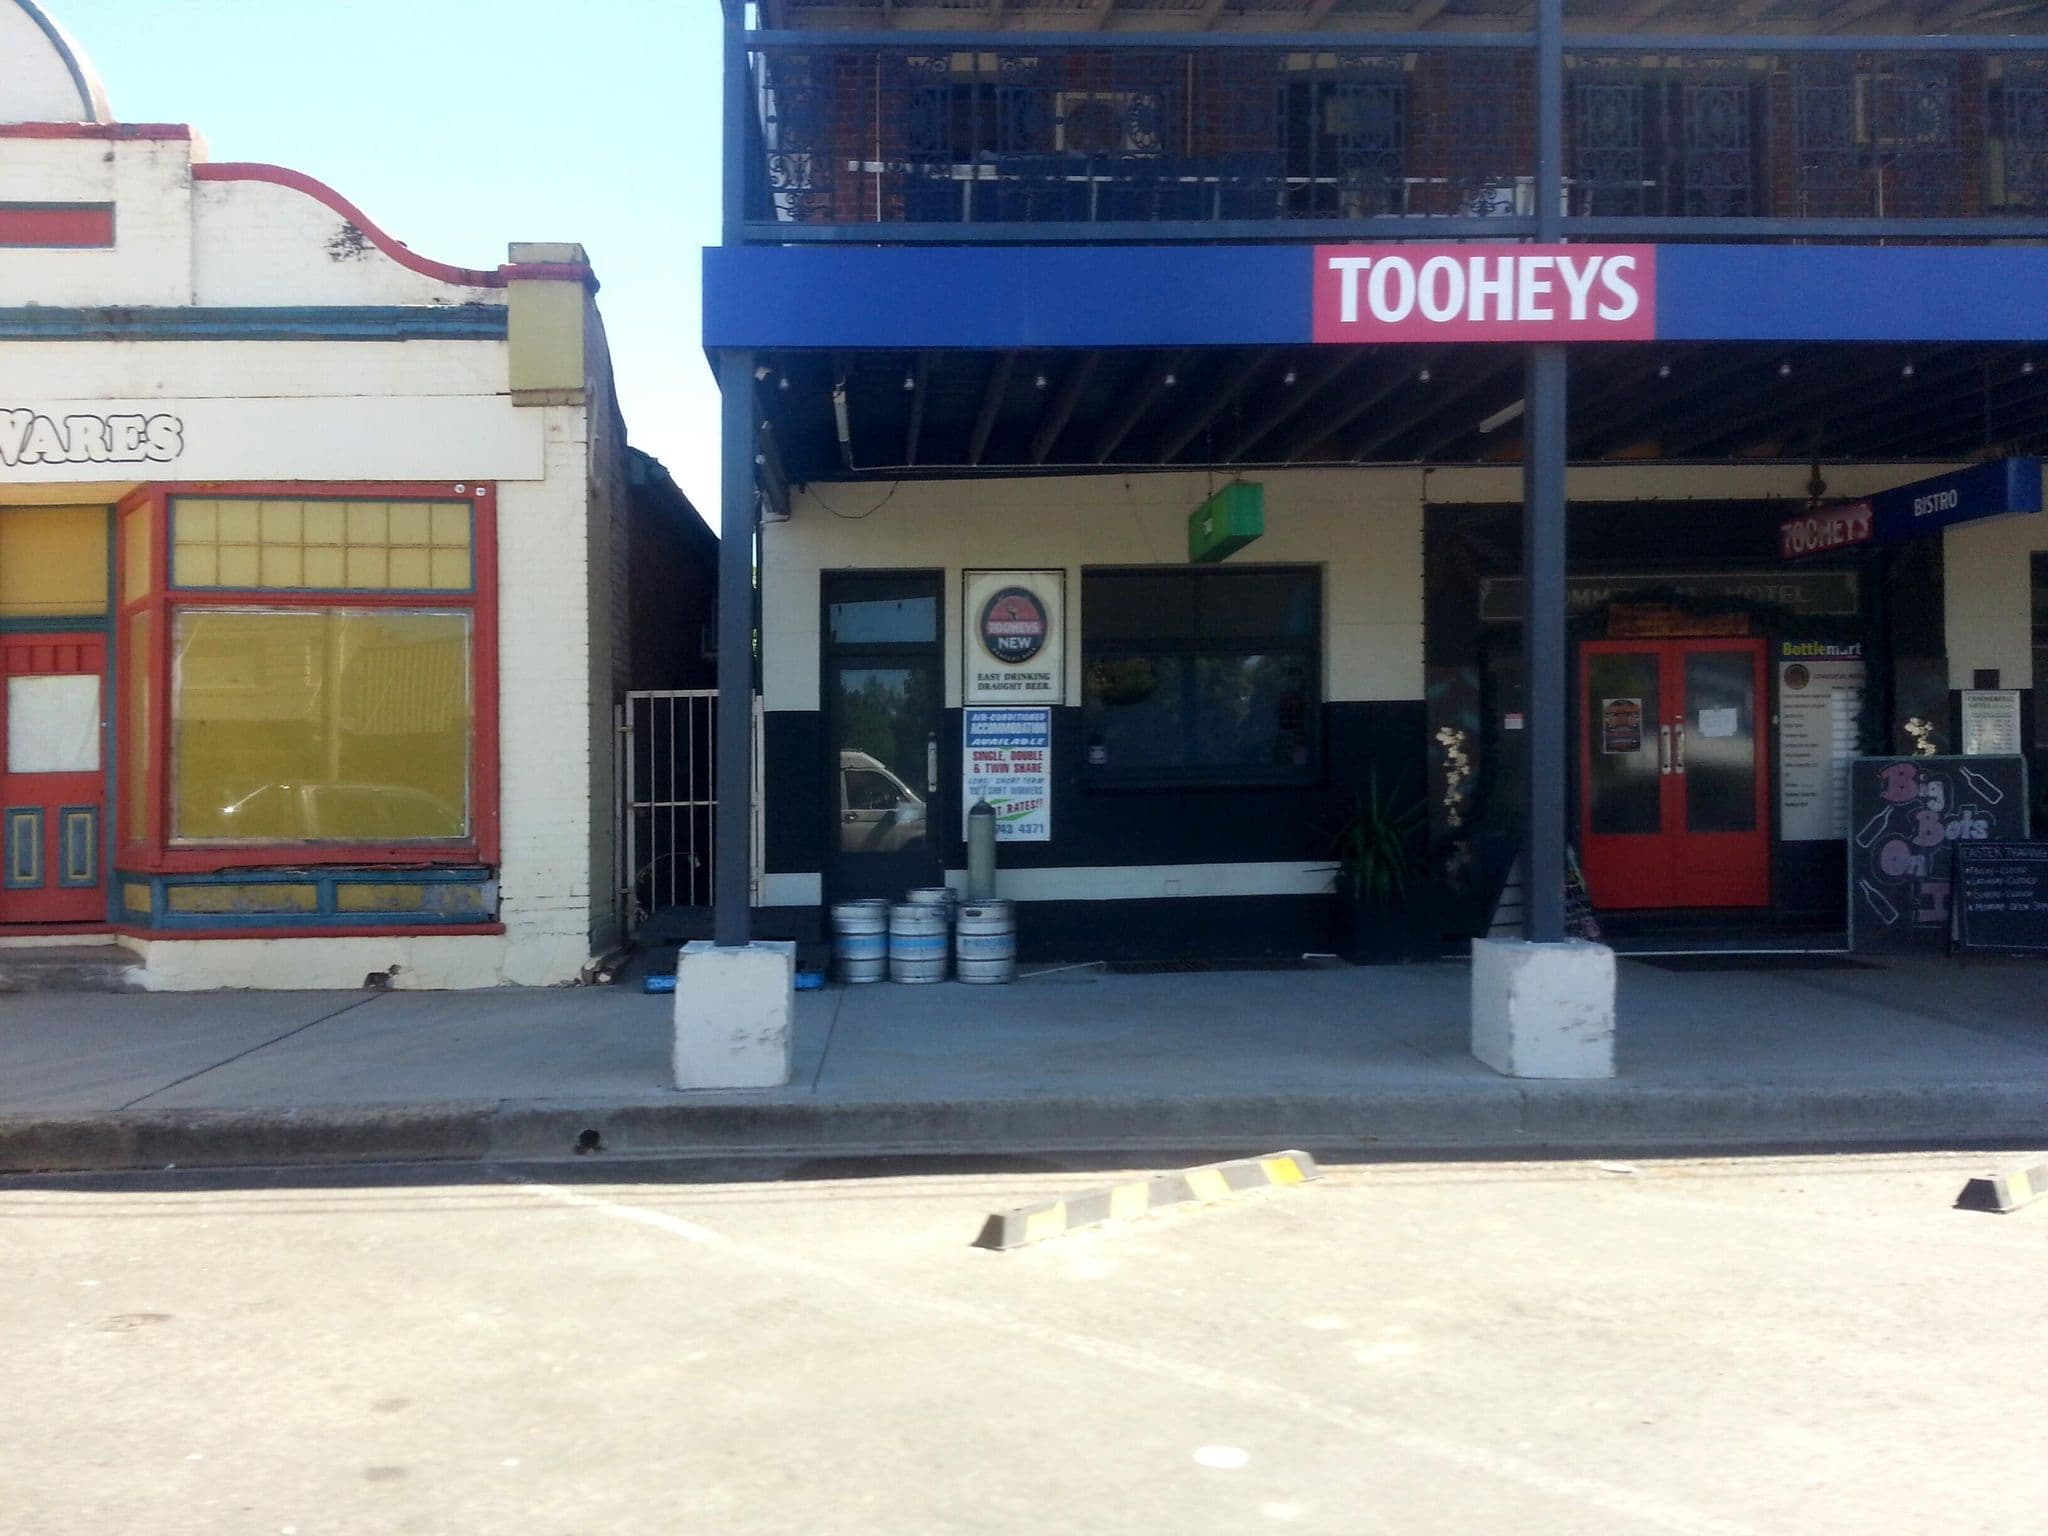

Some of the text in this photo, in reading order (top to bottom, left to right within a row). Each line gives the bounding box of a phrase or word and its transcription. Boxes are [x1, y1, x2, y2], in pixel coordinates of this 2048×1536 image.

[1328, 255, 1640, 323] TOOHEYS
[1913, 489, 1958, 517] BISTRO
[998, 636, 1033, 649] NEW
[977, 672, 1051, 681] EASY DRINKING
[977, 682, 1023, 691] DRAUGHT
[971, 737, 1046, 746] AVAILABLE
[1010, 750, 1044, 761] DOUBLE
[973, 763, 1042, 773] & TWIN SHARE
[1879, 763, 1945, 812] Big
[1018, 823, 1044, 834] 4371
[1880, 838, 1928, 877] On
